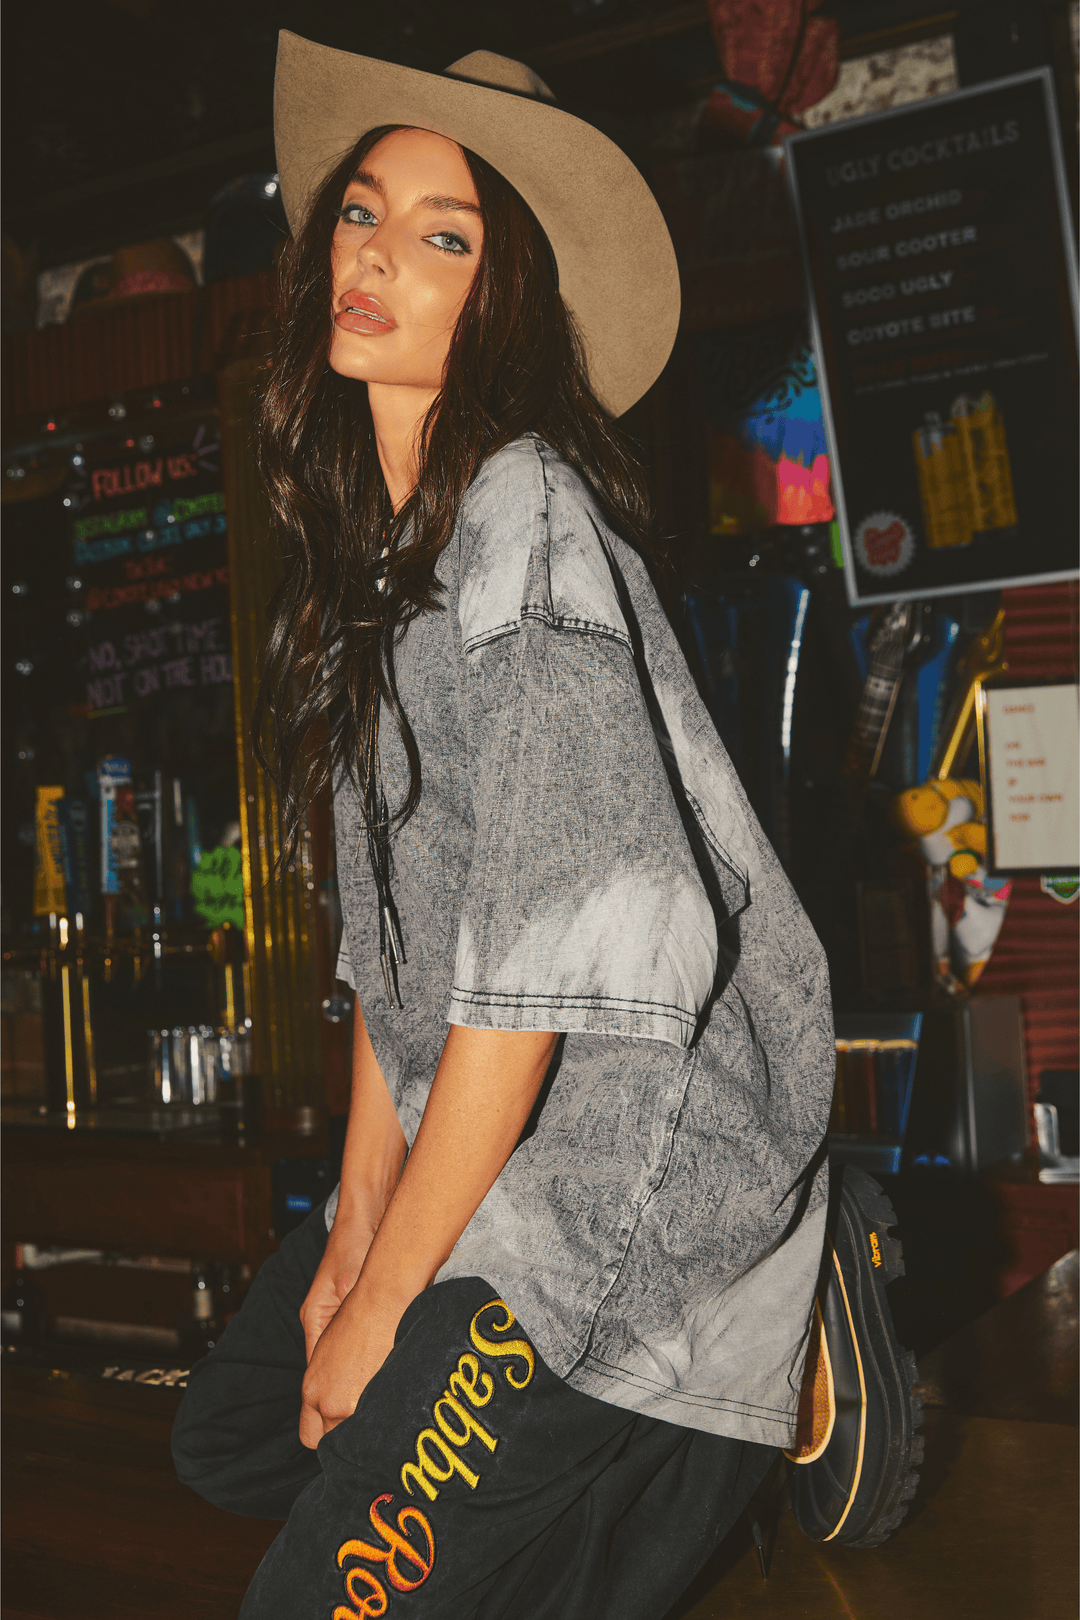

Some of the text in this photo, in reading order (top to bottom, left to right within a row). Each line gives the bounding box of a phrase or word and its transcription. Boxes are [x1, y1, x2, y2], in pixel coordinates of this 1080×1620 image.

[826, 120, 1020, 187] UGLY COCKTAILS
[830, 188, 963, 234] JADE ORCHID
[836, 224, 978, 271] SOUR COOTER
[841, 270, 954, 309] SOCO UGLY
[846, 305, 977, 346] COYOTE BITE
[91, 457, 163, 500] FOLLOW
[123, 624, 167, 666] SHOT
[86, 671, 126, 710] NOT
[134, 665, 161, 697] ON
[161, 655, 195, 688] THE
[869, 1231, 882, 1268] vibram
